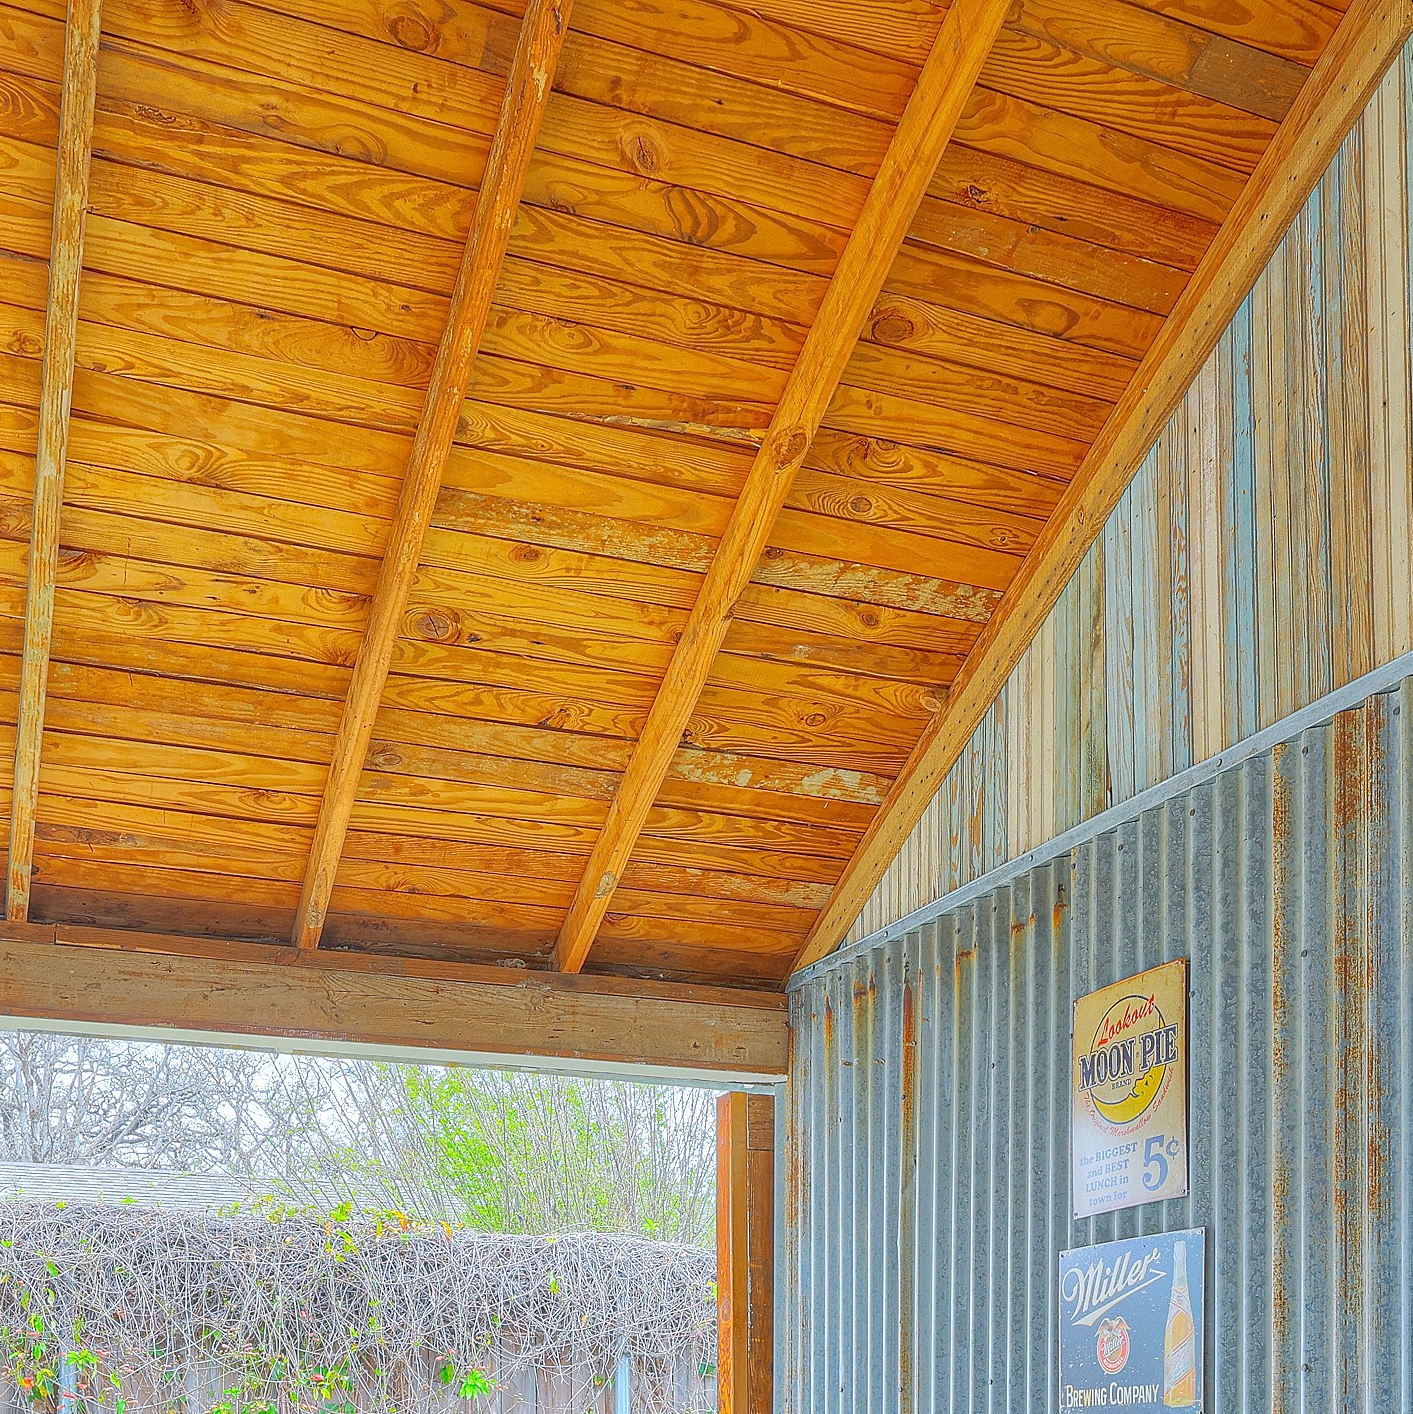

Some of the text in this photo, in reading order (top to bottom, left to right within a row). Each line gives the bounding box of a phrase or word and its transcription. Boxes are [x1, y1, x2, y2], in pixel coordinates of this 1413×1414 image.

[1098, 994, 1155, 1047] Lookout
[1079, 1024, 1178, 1090] MOON PIE
[1112, 1079, 1131, 1090] BRAND
[1110, 1114, 1151, 1137] Marshmallow
[1153, 1067, 1174, 1113] Sandwich
[1080, 1142, 1138, 1166] the BIGGEST
[1087, 1159, 1129, 1178] and BEST
[1085, 1175, 1129, 1193] LUNCH in
[1089, 1191, 1128, 1206] town for
[1062, 1247, 1161, 1321] Miller
[1099, 1336, 1123, 1356] Miller
[1066, 1382, 1159, 1408] BREWING COMPANY
